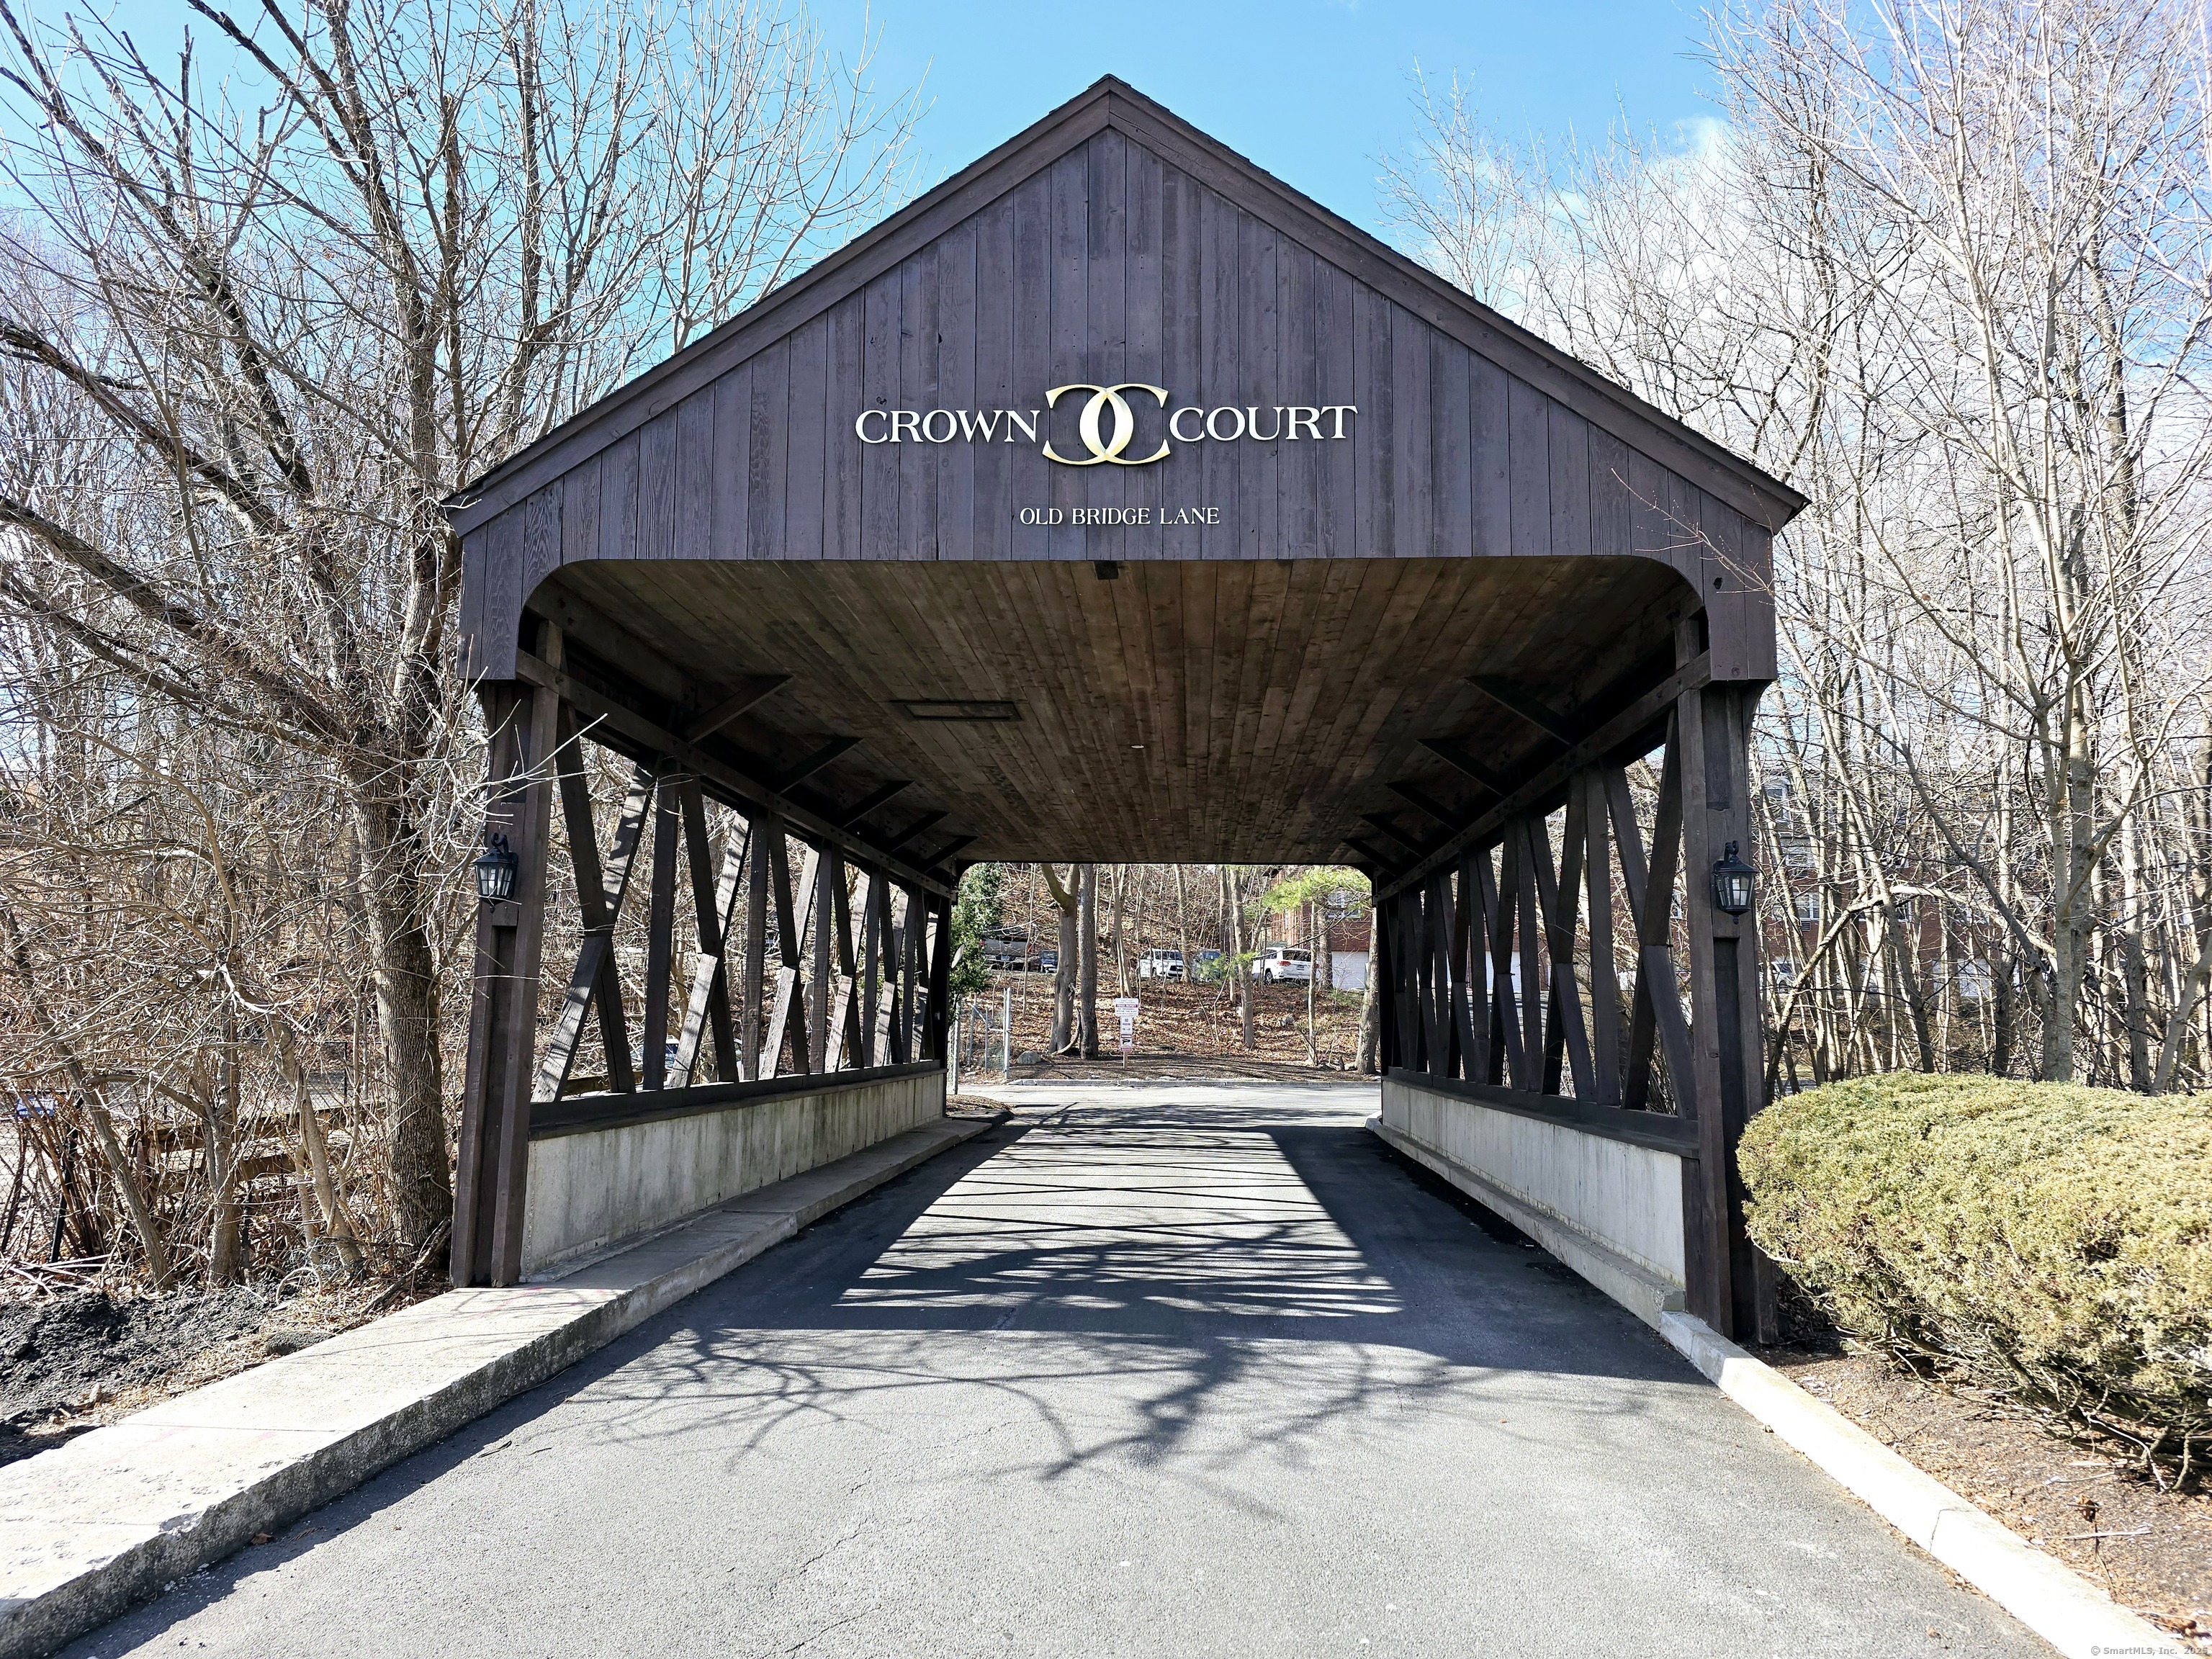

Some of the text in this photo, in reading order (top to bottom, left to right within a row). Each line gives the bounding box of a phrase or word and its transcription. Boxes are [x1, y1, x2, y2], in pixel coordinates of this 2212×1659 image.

[855, 409, 1040, 444] CROWN
[1170, 405, 1358, 442] COURT
[1020, 507, 1220, 525] OLD BRIDGE LANE
